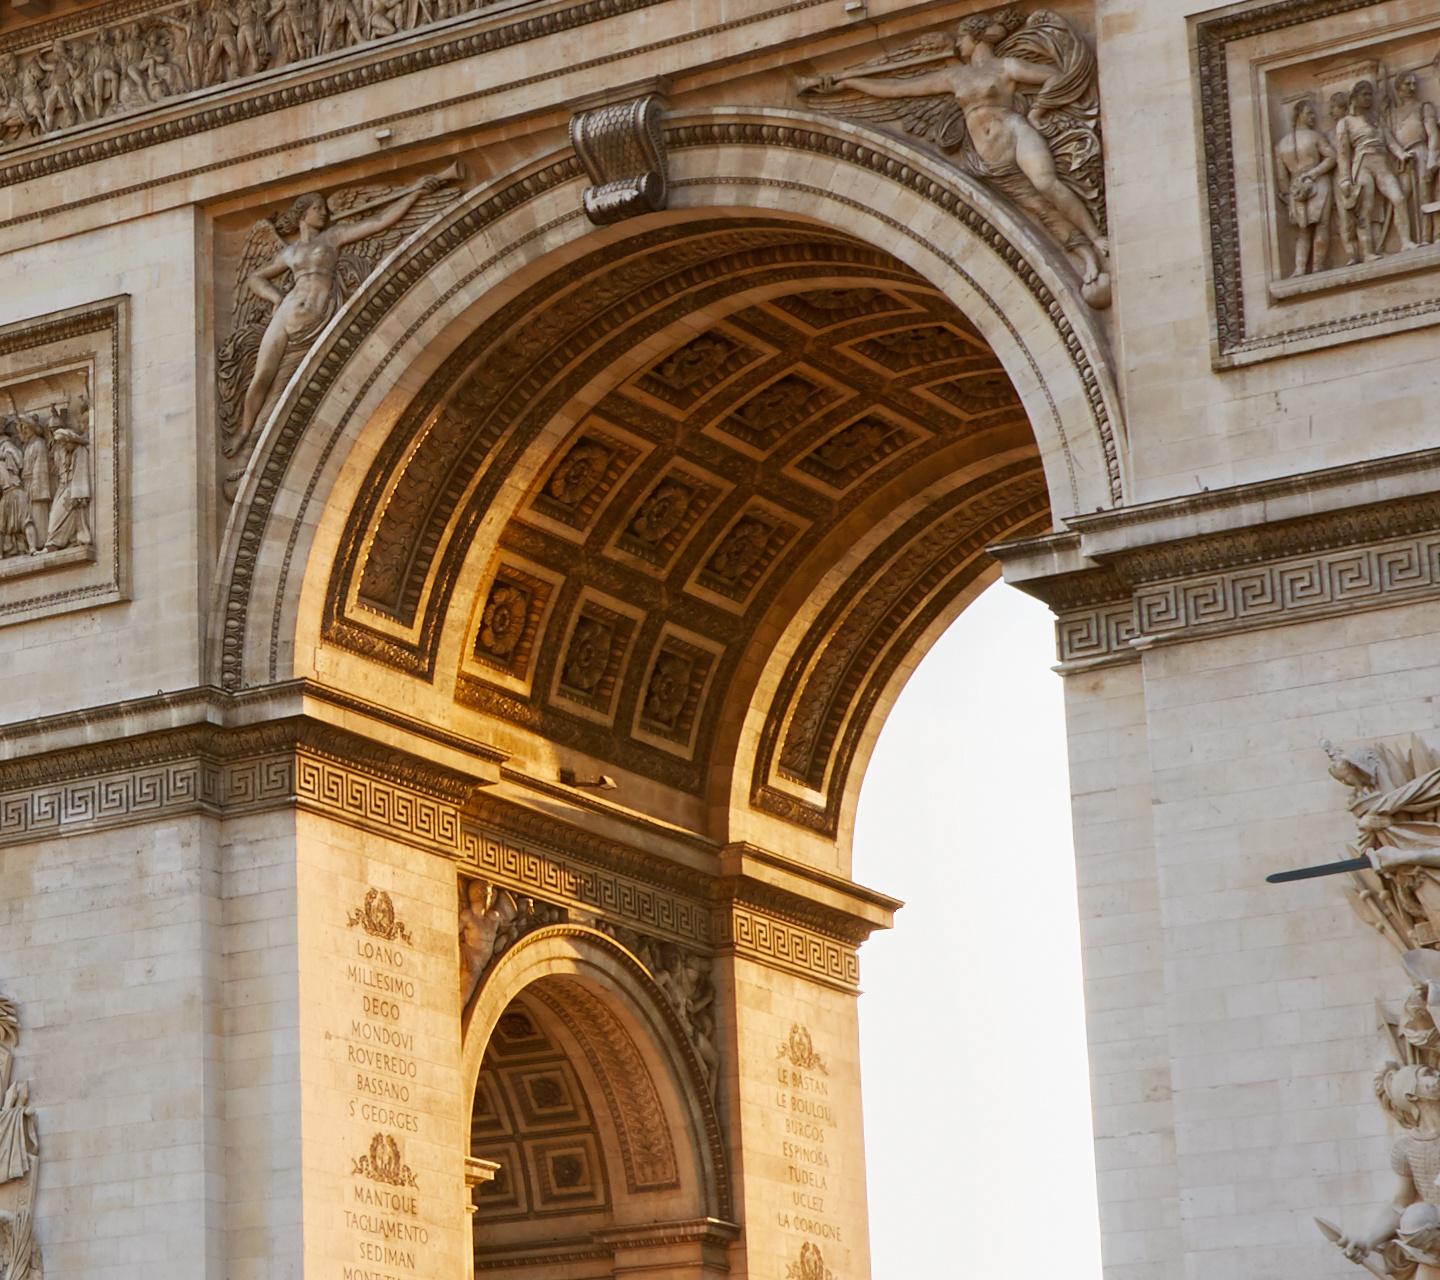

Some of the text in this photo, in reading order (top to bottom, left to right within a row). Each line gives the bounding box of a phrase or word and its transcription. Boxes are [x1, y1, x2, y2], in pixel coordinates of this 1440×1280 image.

[357, 940, 403, 967] LOANO
[347, 965, 415, 998] MILLESIMO
[363, 995, 400, 1020] DEGO
[351, 1019, 414, 1051] MONDOVI
[348, 1045, 417, 1078] ROVEREDO
[357, 1074, 409, 1102] BASSANO
[777, 1068, 828, 1095] LE BASTAN
[361, 1104, 418, 1132] GEORGES
[777, 1091, 831, 1121] LE BOULOU
[786, 1119, 824, 1143] BURGOS
[783, 1142, 830, 1168] ESPINOSA
[788, 1166, 828, 1190] TUDELA
[354, 1186, 417, 1215] MANTOUE
[793, 1192, 824, 1213] UCLEZ
[344, 1210, 429, 1244] TAGLIAMENTO
[778, 1212, 842, 1242] LA COROGNE
[360, 1242, 415, 1269] SEDIMAN
